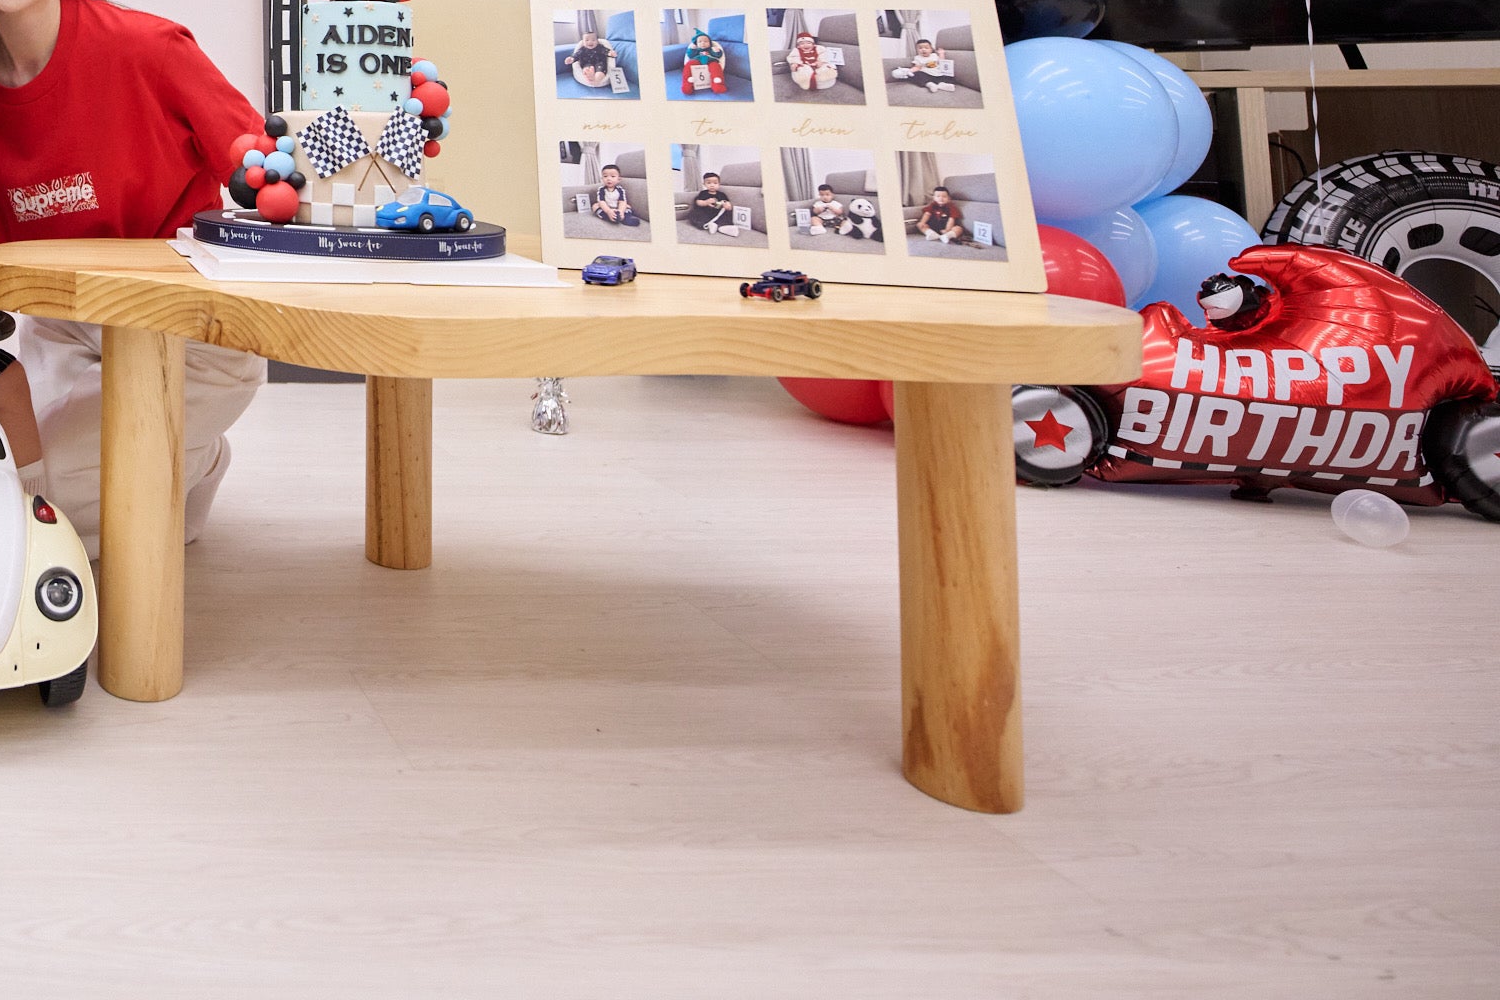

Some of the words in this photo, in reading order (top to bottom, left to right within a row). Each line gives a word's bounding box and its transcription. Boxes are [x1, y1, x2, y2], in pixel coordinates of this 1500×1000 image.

[321, 25, 412, 48] AIDEN
[316, 53, 348, 74] IS
[359, 53, 412, 77] ONE
[582, 119, 627, 131] nine
[690, 117, 733, 137] ten
[791, 118, 855, 137] eleven
[900, 120, 978, 140] twelve
[13, 183, 94, 216] Supreme
[219, 227, 230, 242] My
[250, 228, 264, 244] Art
[318, 236, 334, 252] My
[337, 237, 364, 249] Sweet
[366, 238, 383, 252] Art
[438, 241, 452, 256] My
[1169, 337, 1415, 408] HAPPY
